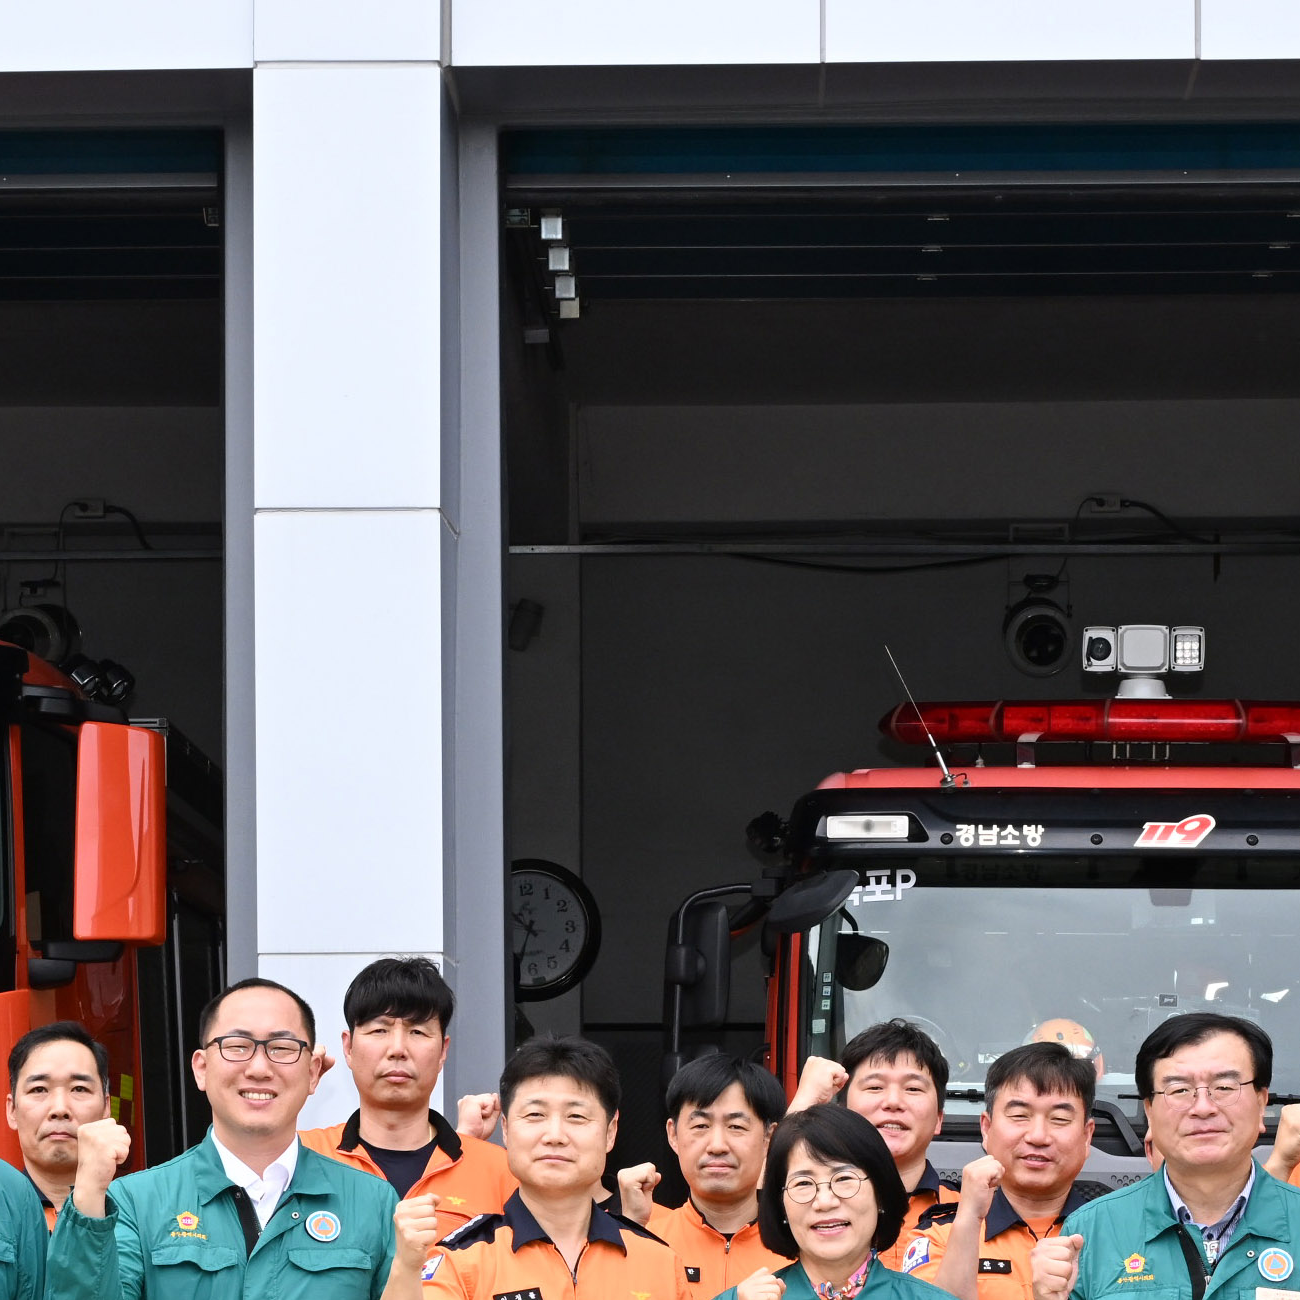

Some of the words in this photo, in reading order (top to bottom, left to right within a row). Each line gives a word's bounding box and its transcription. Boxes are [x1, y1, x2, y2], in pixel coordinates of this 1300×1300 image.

[956, 824, 1044, 847] 경남소방
[1139, 814, 1214, 846] 119
[519, 882, 534, 897] 12
[543, 886, 550, 900] 1
[557, 900, 568, 913] 2
[565, 920, 576, 934] 3
[559, 939, 570, 953] 4
[528, 963, 538, 977] 6
[546, 956, 558, 970] 5
